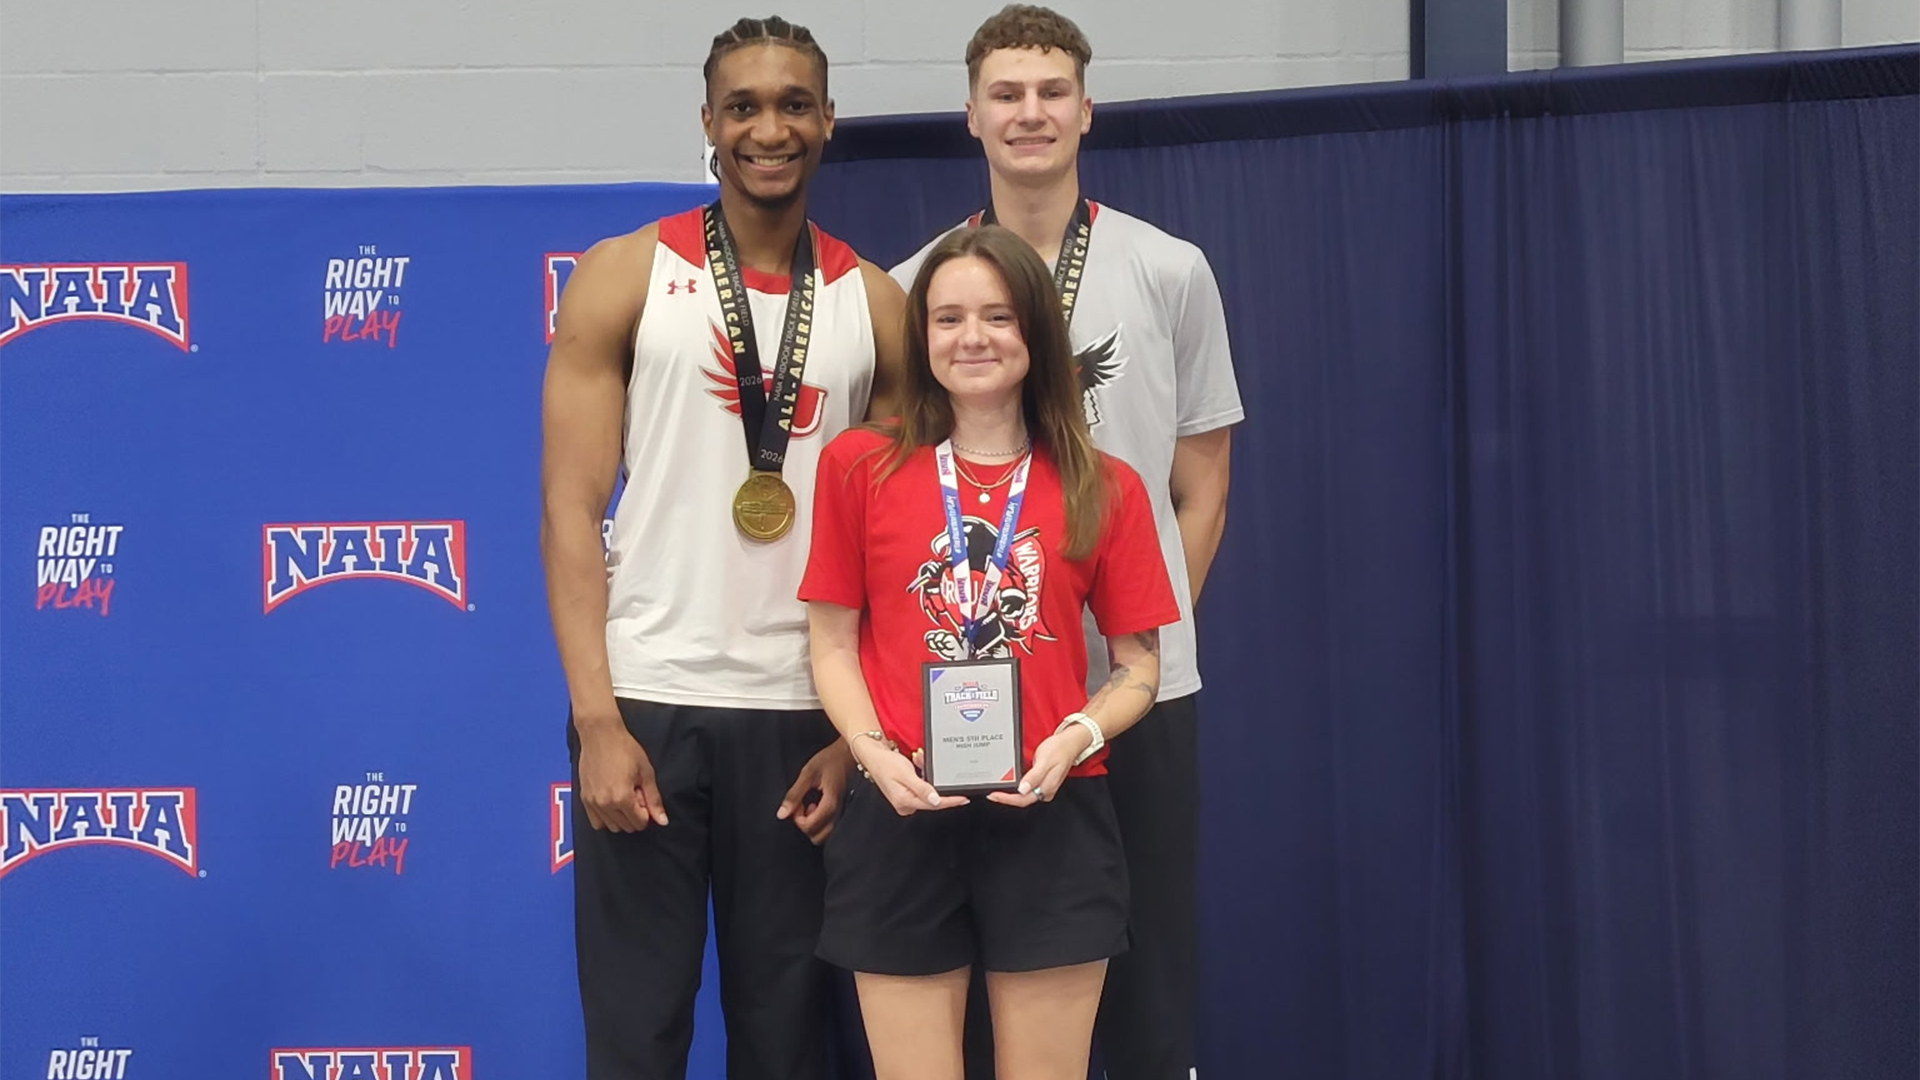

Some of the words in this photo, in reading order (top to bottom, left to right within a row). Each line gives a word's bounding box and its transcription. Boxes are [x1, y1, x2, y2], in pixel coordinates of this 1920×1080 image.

[358, 245, 377, 256] THE
[1062, 238, 1073, 258] FIELD
[324, 256, 410, 289] RIGHT
[705, 210, 746, 354] ALL-AMERICAN
[0, 266, 185, 342] NAIA
[324, 290, 384, 320] WAY
[387, 295, 400, 306] TO
[739, 304, 750, 327] FIELD
[322, 310, 403, 349] PLAY
[778, 344, 792, 380] INDOOR
[785, 319, 797, 344] TRACK
[791, 290, 801, 311] FIELD
[777, 273, 814, 432] ALL-AMERICAN
[739, 375, 763, 387] 2026
[760, 448, 783, 464] 2026
[71, 513, 90, 524] THE
[37, 525, 124, 557] RIGHT
[36, 558, 97, 589] WAY
[100, 563, 113, 574] TO
[266, 525, 462, 604] NAIA
[35, 577, 115, 617] PLAY
[981, 733, 1004, 741] PLACE
[366, 772, 384, 782] THE
[332, 784, 418, 815] RIGHT
[0, 791, 193, 868] NAIA
[331, 817, 390, 847] WAY
[394, 822, 407, 832] TO
[329, 837, 409, 875] PLAY
[80, 1036, 99, 1048] THE
[46, 1049, 133, 1080] RIGHT
